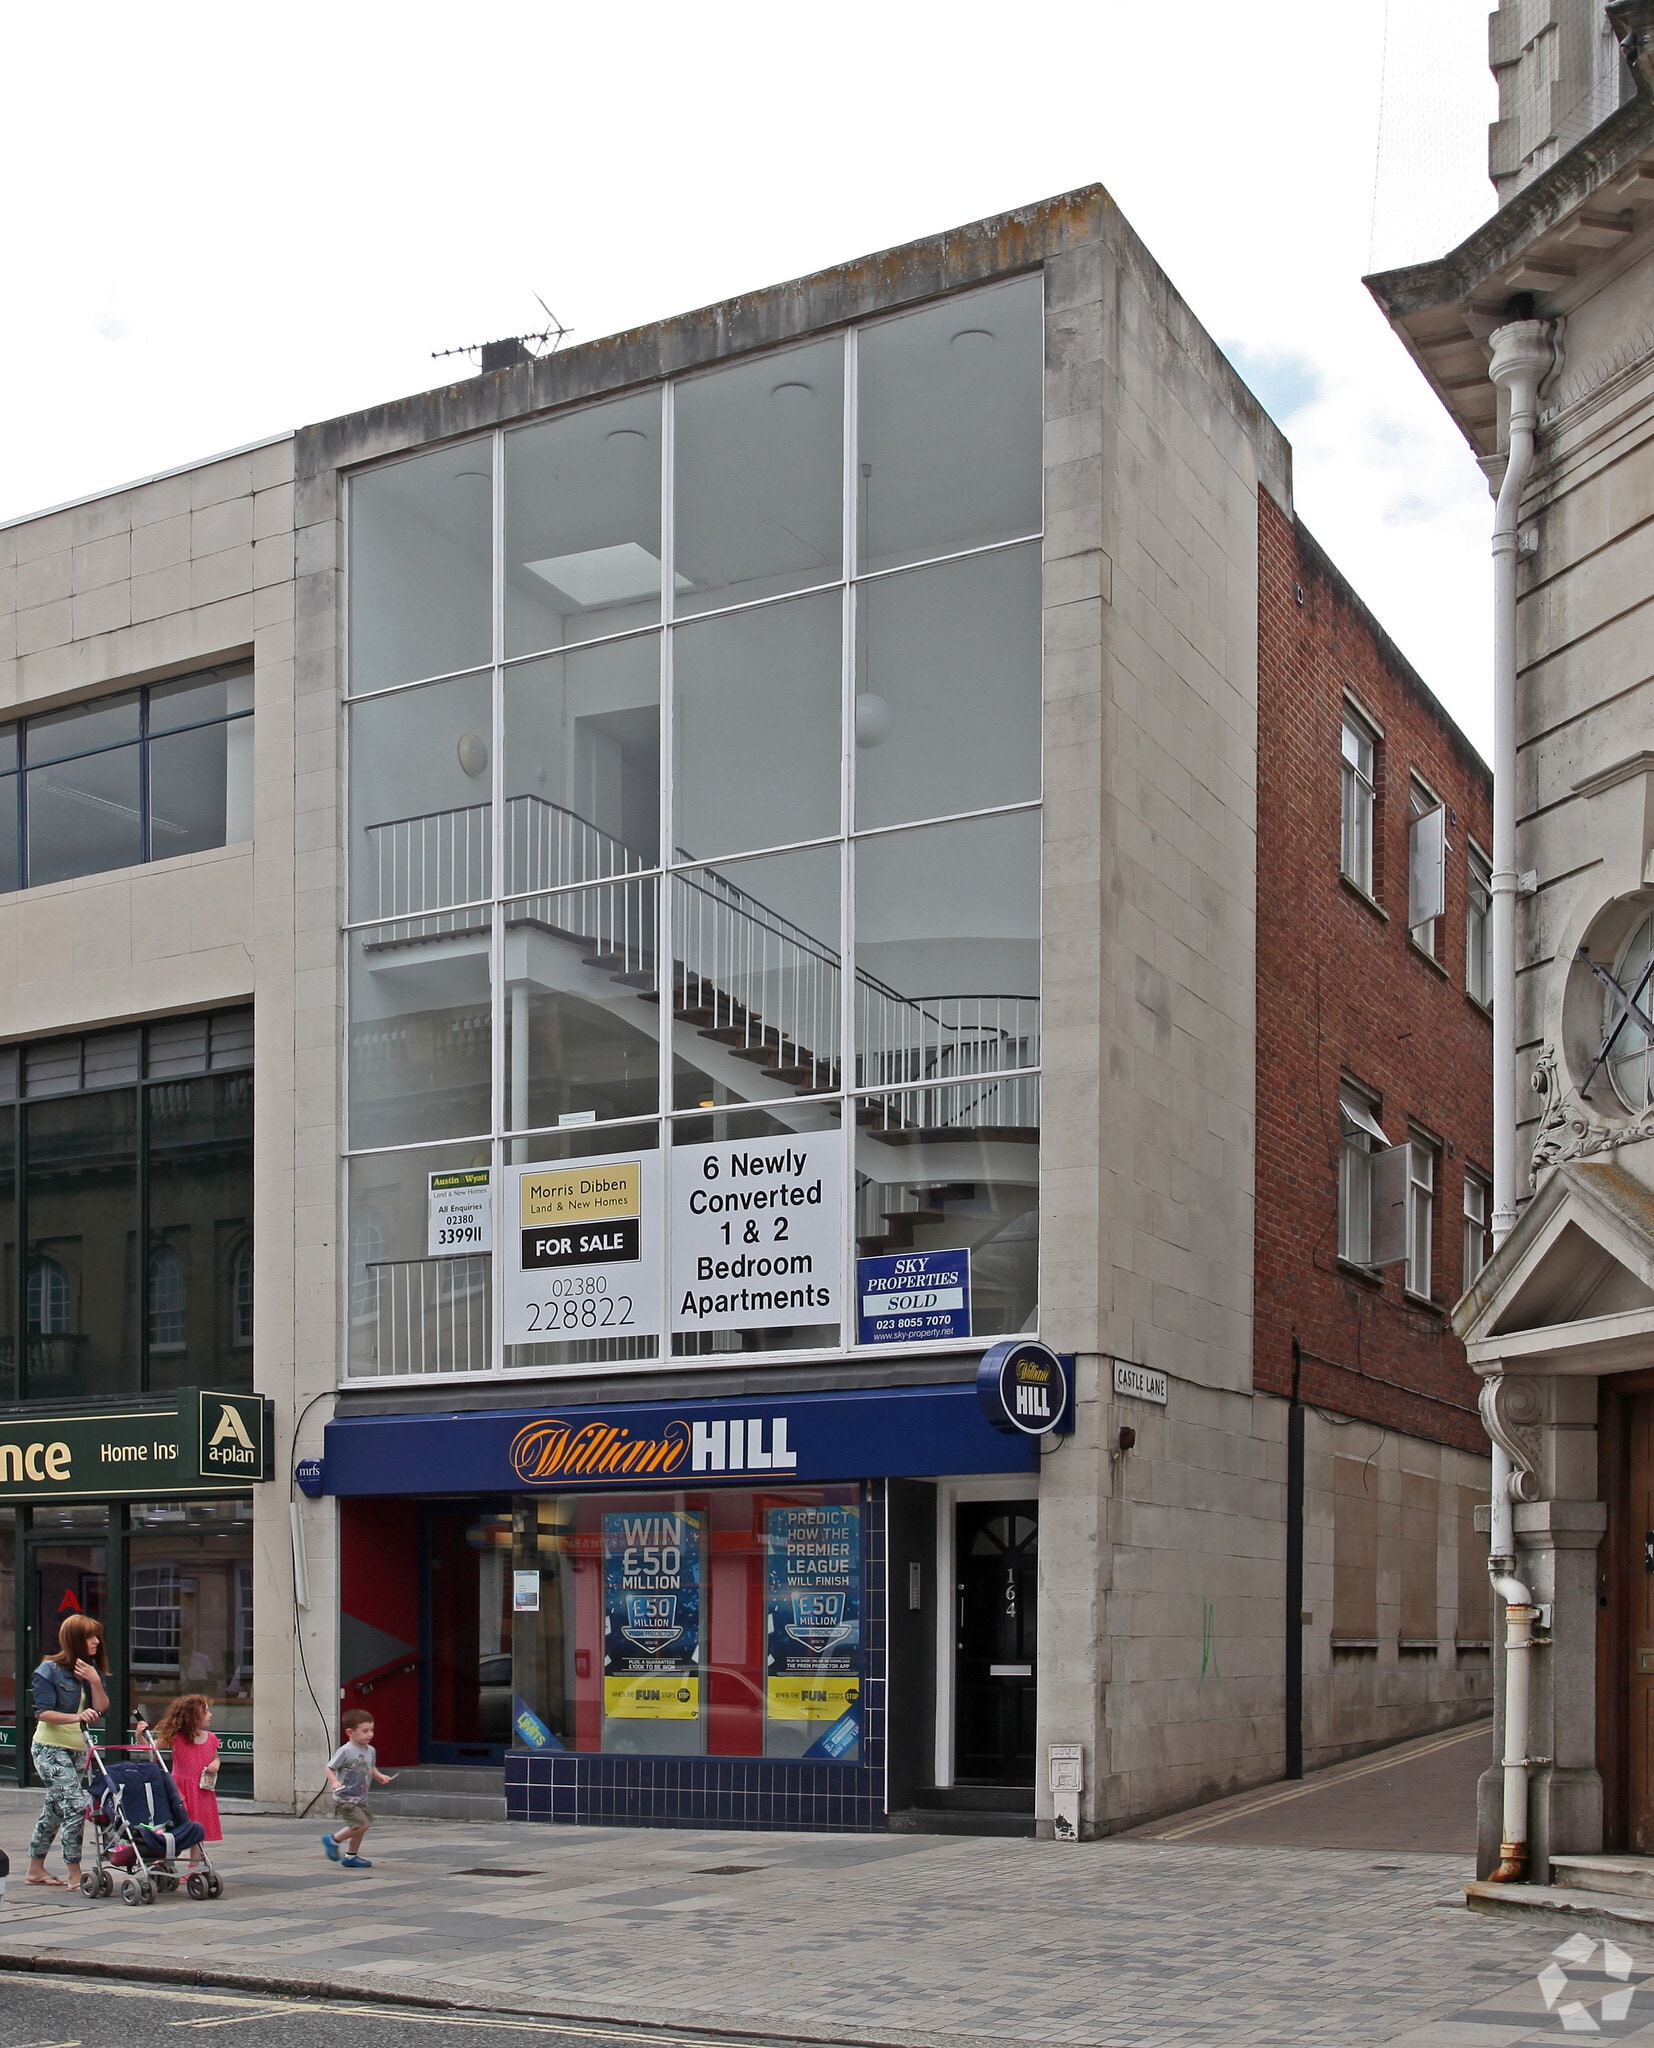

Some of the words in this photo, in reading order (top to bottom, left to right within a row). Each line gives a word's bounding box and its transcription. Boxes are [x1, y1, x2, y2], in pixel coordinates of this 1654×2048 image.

[703, 1155, 720, 1180] 6
[731, 1148, 808, 1177] Newly
[433, 1176, 460, 1187] Austin
[464, 1173, 488, 1184] Wyatt
[530, 1184, 574, 1199] Morris
[580, 1179, 627, 1194] Dibben
[454, 1189, 466, 1197] New
[689, 1179, 823, 1215] Converted
[438, 1205, 449, 1213] All
[450, 1202, 483, 1213] Enquiries
[530, 1203, 553, 1214] Land
[556, 1202, 564, 1212] &
[568, 1199, 591, 1210] New
[594, 1196, 629, 1208] Homes
[446, 1214, 474, 1226] 02380
[438, 1226, 482, 1245] 339911
[720, 1221, 731, 1245] 1
[743, 1219, 761, 1244] &
[773, 1216, 789, 1242] 2
[535, 1238, 573, 1257] FOR
[579, 1232, 624, 1253] SALE
[697, 1253, 812, 1281] Bedroom
[894, 1257, 930, 1274] SKY
[552, 1275, 608, 1297] 02380
[866, 1271, 959, 1292] PROPERTIES
[680, 1284, 831, 1319] Apartments
[887, 1293, 938, 1311] SOLD
[526, 1295, 636, 1333] 228822
[876, 1319, 896, 1330] 023
[898, 1317, 923, 1328] 8055
[926, 1314, 952, 1326] 7070
[873, 1326, 954, 1341] www.sky-property.net
[1016, 1358, 1051, 1384] William
[1118, 1368, 1144, 1391] CASTLE
[1146, 1376, 1165, 1397] LANE
[1016, 1385, 1050, 1417] HILL
[208, 1403, 256, 1449] A
[101, 1443, 148, 1463] Home
[153, 1441, 179, 1461] Ins
[209, 1445, 255, 1465] a-plan
[509, 1418, 692, 1484] William
[692, 1417, 797, 1472] HILL
[299, 1463, 321, 1477] mrfs
[788, 1511, 850, 1525] PREDICT
[622, 1517, 681, 1546] WIN
[788, 1527, 819, 1541] HOW
[823, 1527, 850, 1540] THE
[787, 1543, 850, 1557] PREMIER
[622, 1546, 681, 1576] £50
[787, 1559, 849, 1574] LEAGUE
[622, 1575, 681, 1590] MILLION
[787, 1576, 813, 1586] WILL
[815, 1576, 850, 1586] FINISH
[1006, 1568, 1016, 1618] 164
[633, 1598, 670, 1618] £50
[799, 1595, 838, 1616] £50
[633, 1618, 670, 1628] MILLION
[799, 1616, 837, 1626] MILLION
[635, 1689, 660, 1701] FUN
[801, 1690, 827, 1702] FUN
[845, 1692, 859, 1700] STOP
[517, 1713, 546, 1747] LIMITS
[227, 1738, 254, 1750] Conte
